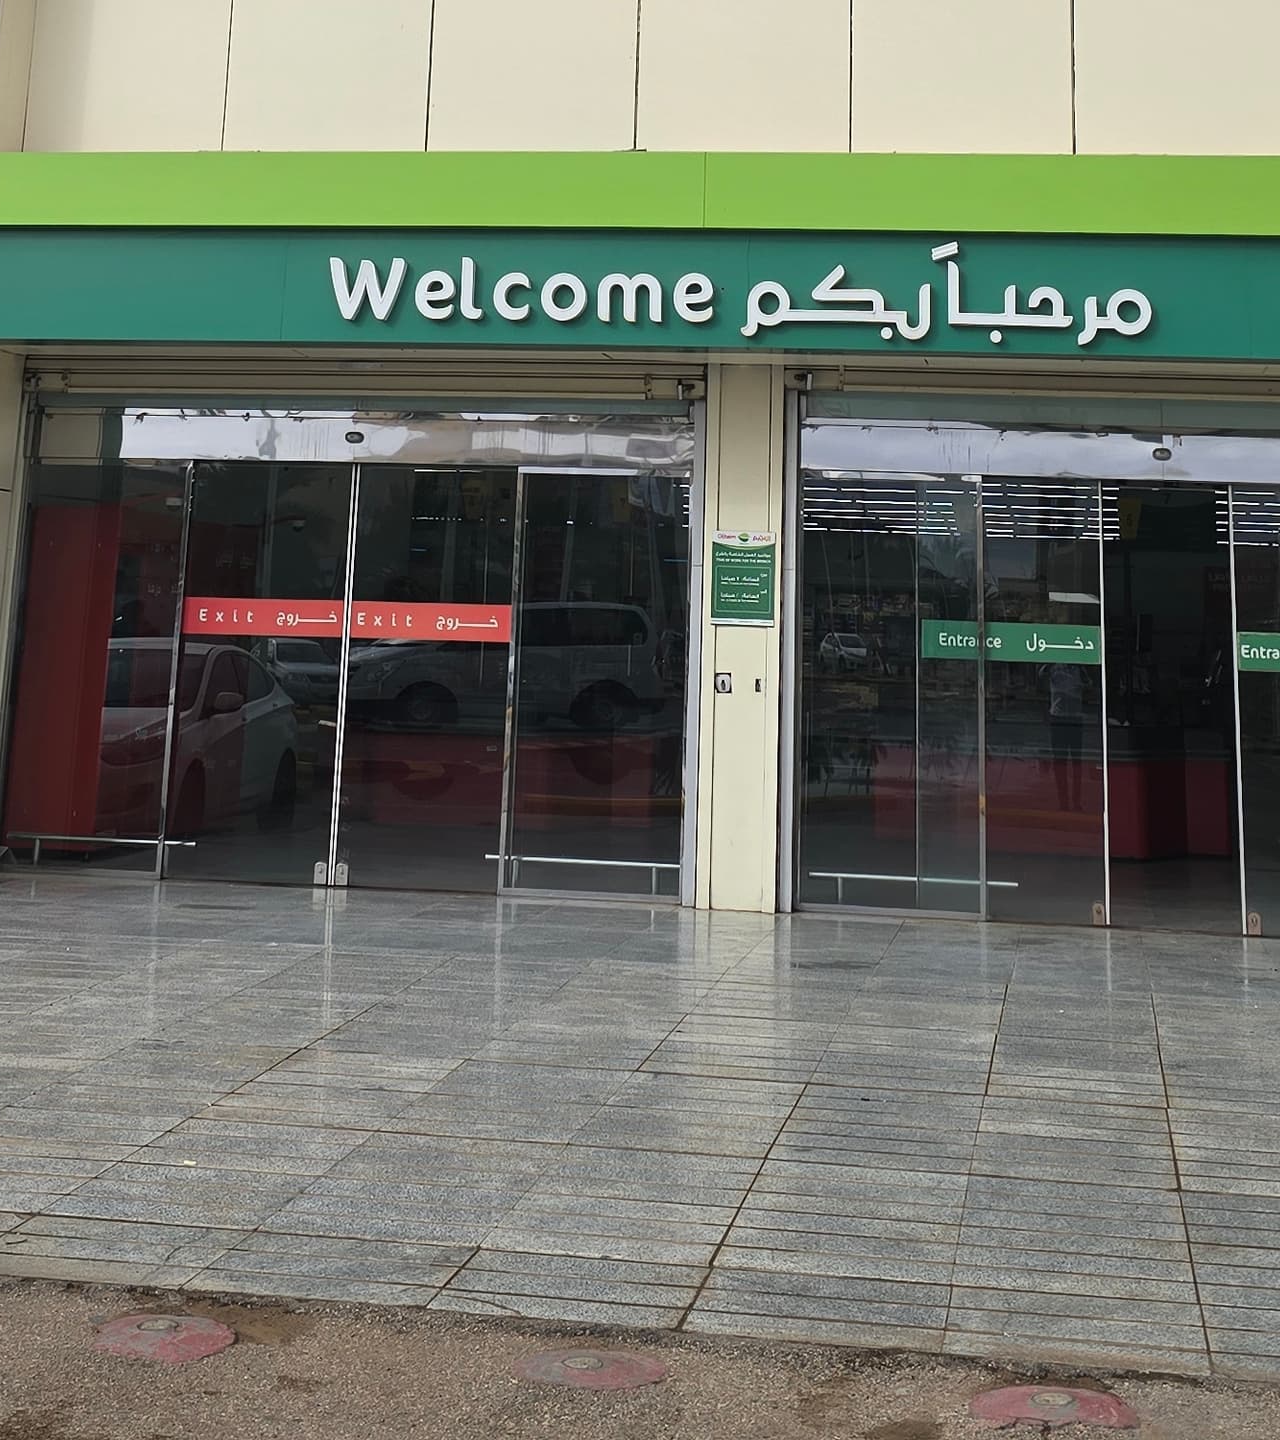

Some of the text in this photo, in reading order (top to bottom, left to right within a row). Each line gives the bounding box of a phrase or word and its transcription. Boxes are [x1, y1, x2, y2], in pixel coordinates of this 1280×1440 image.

[329, 256, 714, 322] Welcome
[740, 264, 931, 340] بكم
[199, 608, 254, 623] Exit
[276, 610, 338, 625] خروج
[357, 612, 413, 628] Exit
[436, 615, 499, 630] خروج
[938, 632, 1002, 649] Entrace
[1026, 632, 1095, 652] دخول
